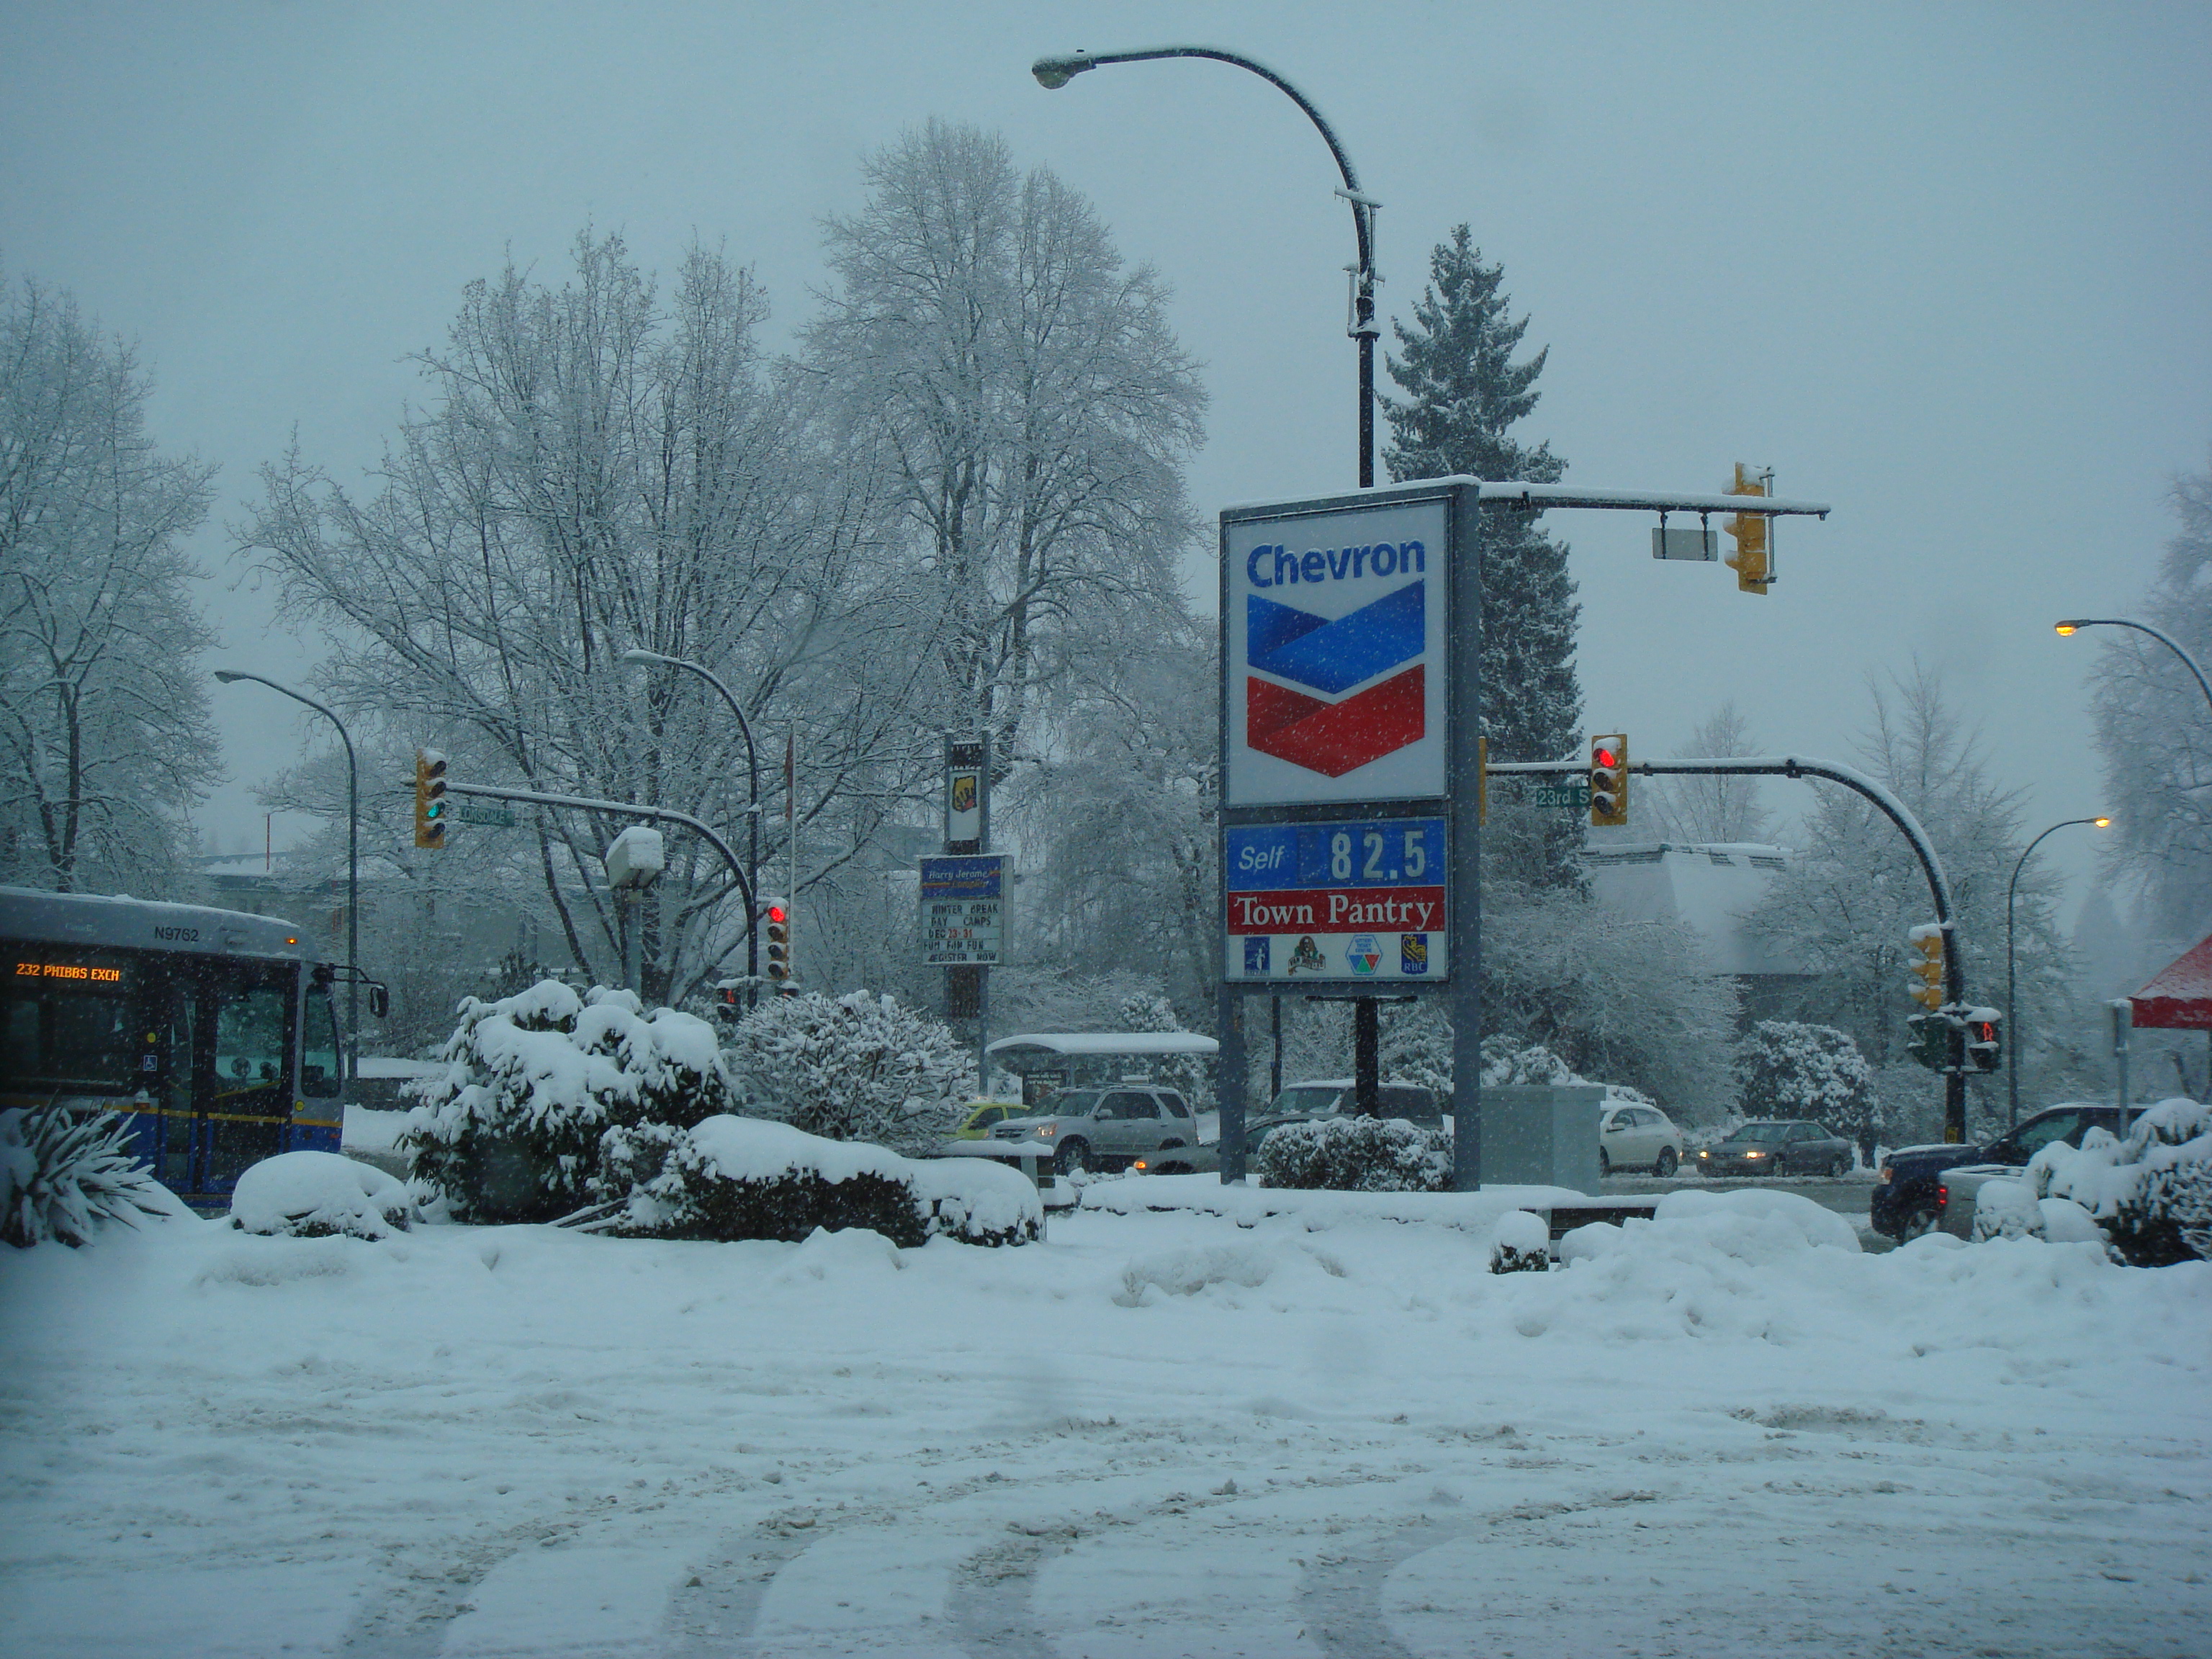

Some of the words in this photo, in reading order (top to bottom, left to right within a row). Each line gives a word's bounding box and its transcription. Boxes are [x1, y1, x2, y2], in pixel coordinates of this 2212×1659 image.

[1246, 540, 1426, 588] Chevron
[1538, 789, 1571, 806] 23rd
[1578, 788, 1592, 804] S
[460, 808, 505, 824] LONSDALE
[1238, 845, 1285, 871] Self
[1331, 830, 1426, 880] 82.5
[929, 870, 954, 881] Harry
[956, 870, 988, 879] Jerome
[932, 905, 963, 915] WINTER
[970, 904, 998, 914] BREAK
[1233, 896, 1315, 925] Town
[1327, 894, 1436, 931] Pantry
[931, 917, 948, 927] DAY
[963, 915, 992, 927] CAMPS
[154, 926, 199, 943] N9762
[928, 928, 945, 939] DEC
[966, 940, 984, 950] FUN
[976, 951, 997, 961] NOW
[16, 963, 40, 976] 232
[42, 965, 88, 980] PHIBBS
[91, 968, 120, 982] EXCH
[1404, 962, 1426, 972] RBC
